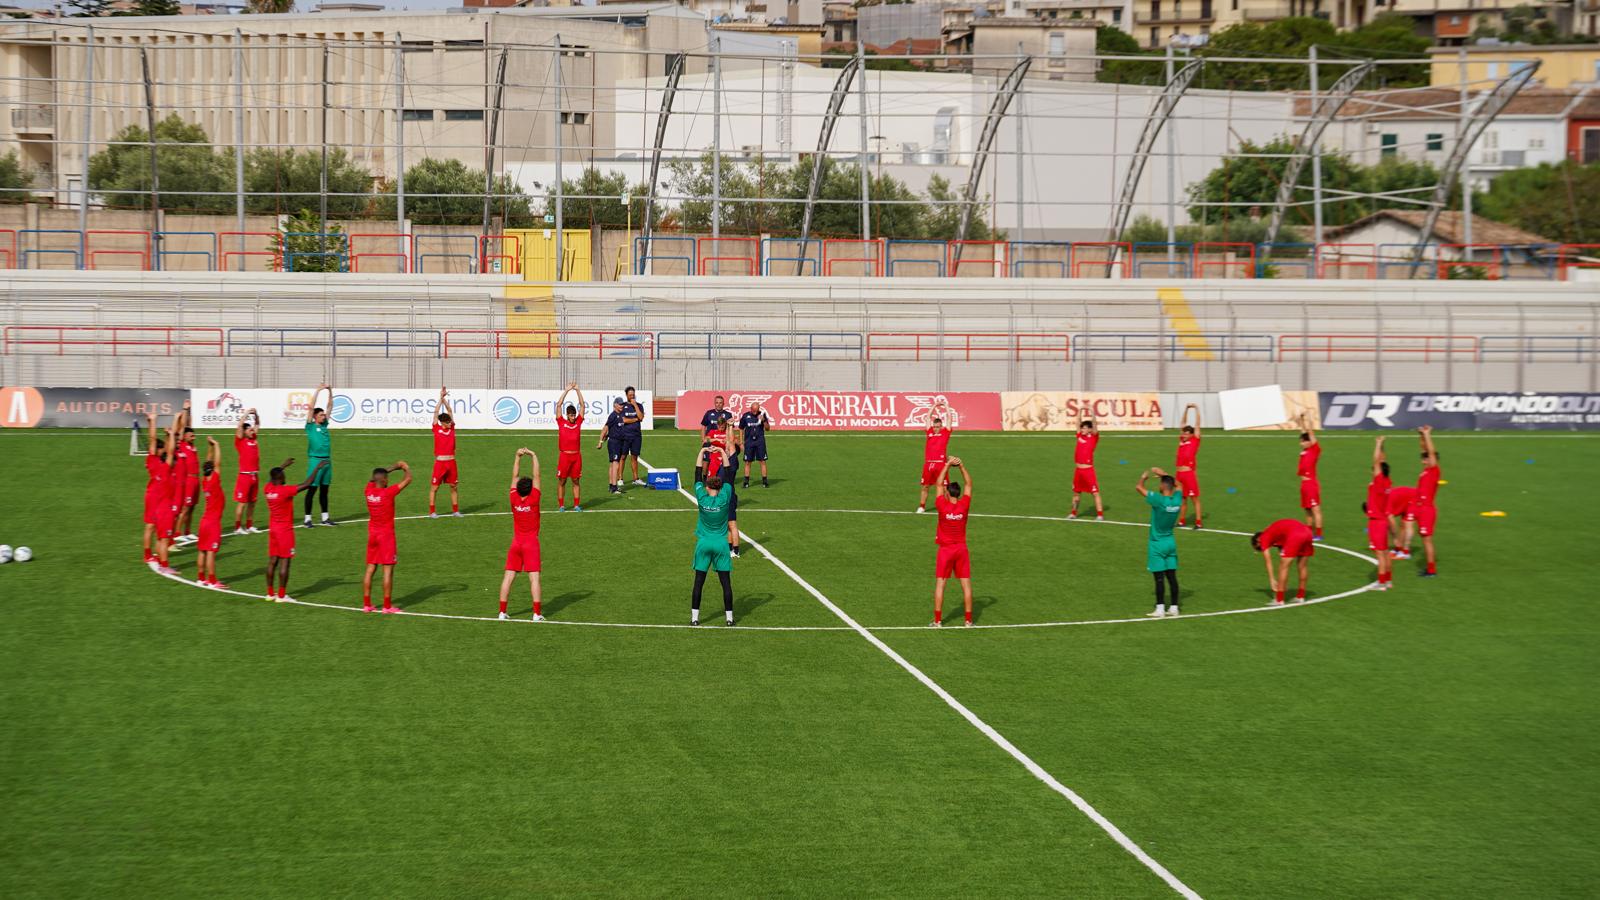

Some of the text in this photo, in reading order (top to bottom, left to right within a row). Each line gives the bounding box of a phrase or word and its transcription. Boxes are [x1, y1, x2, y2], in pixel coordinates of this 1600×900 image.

[56, 401, 173, 414] AUTOPARTS
[361, 394, 481, 414] ermesnk
[778, 394, 897, 417] GENERALI
[1065, 398, 1162, 417] SICULA
[1323, 394, 1400, 426] DR
[391, 416, 434, 424] OVUNQU
[779, 418, 900, 427] AGENZIA DI MODICA
